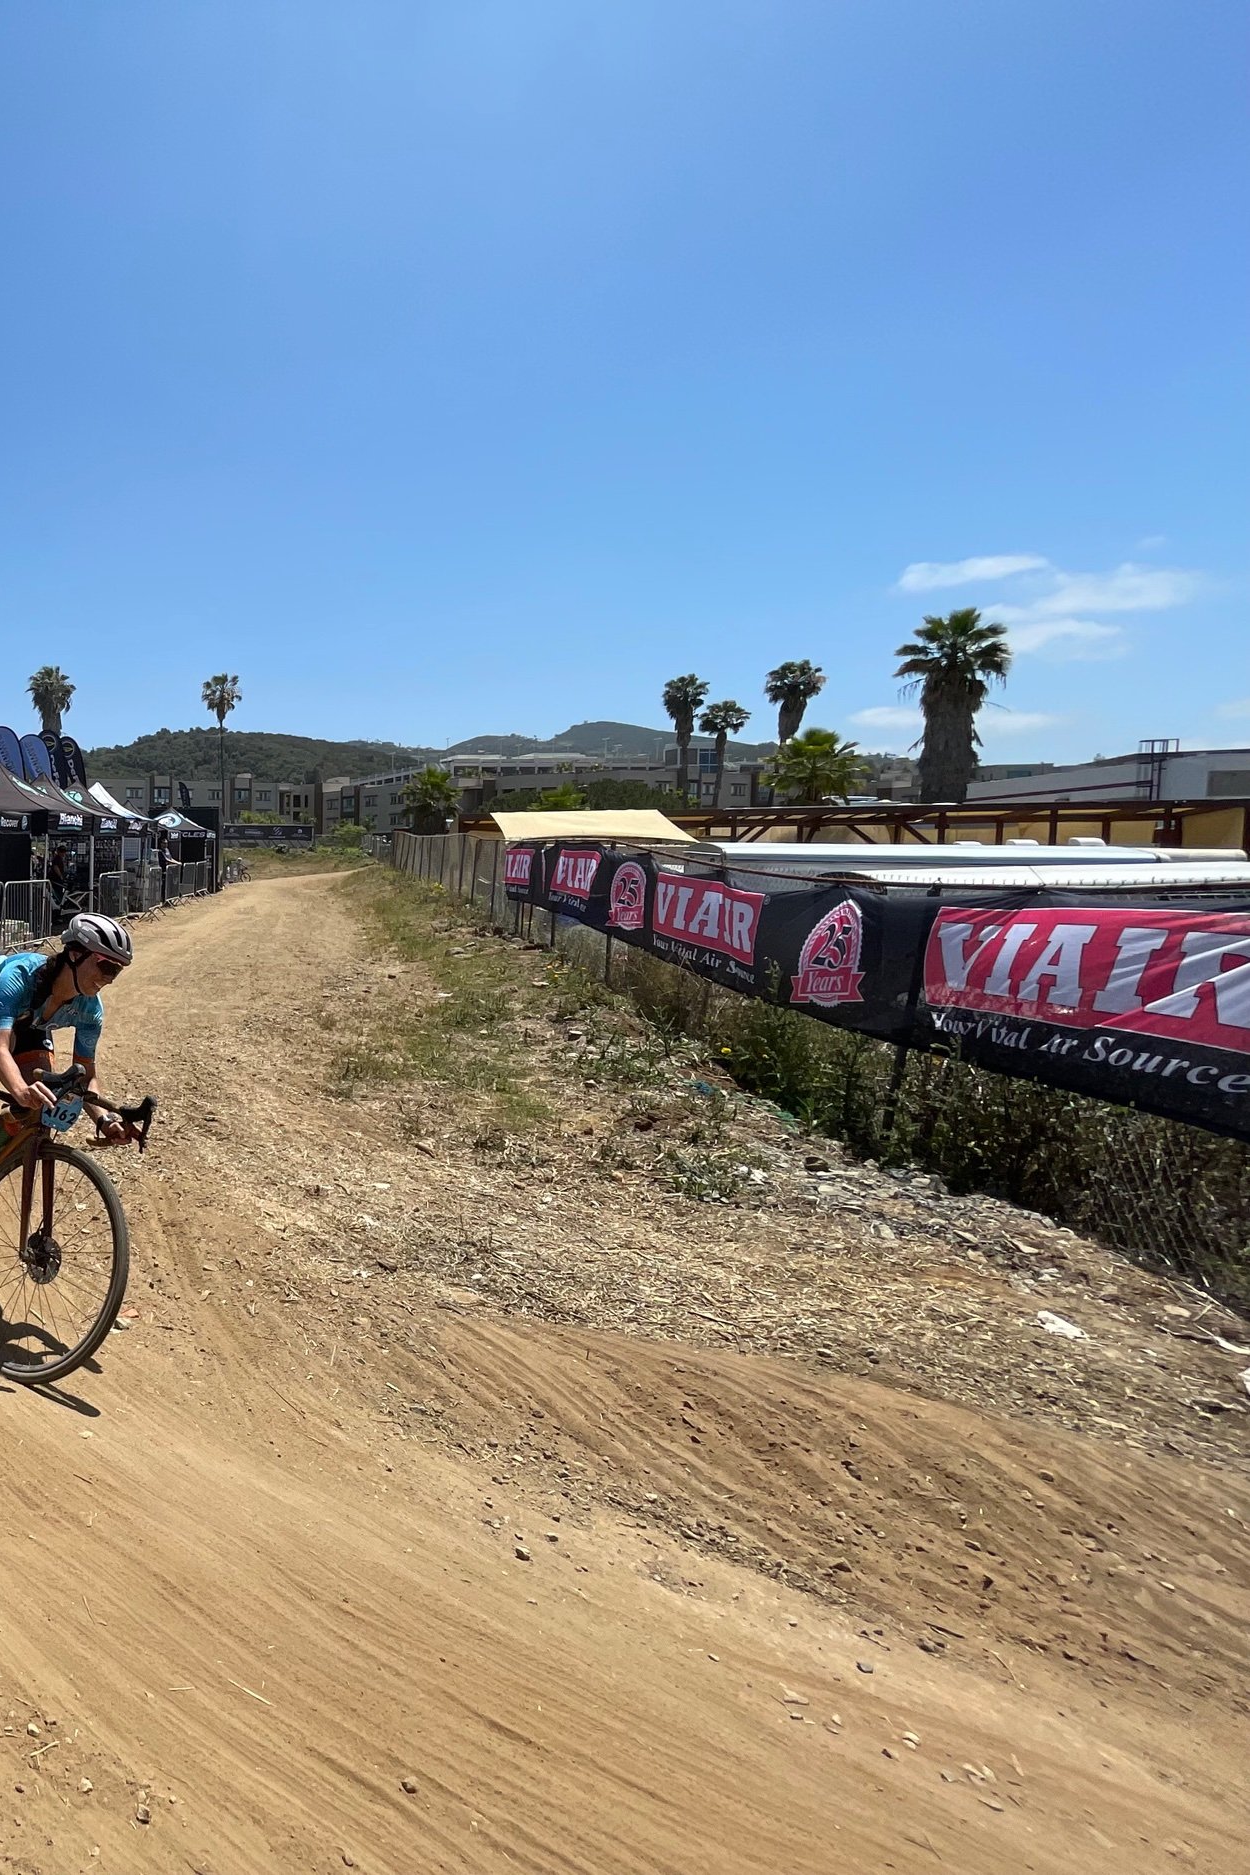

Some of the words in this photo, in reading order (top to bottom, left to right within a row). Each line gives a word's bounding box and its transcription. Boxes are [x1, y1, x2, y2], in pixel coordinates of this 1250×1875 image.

[0, 816, 20, 828] Recover
[616, 876, 640, 907] 25
[616, 907, 638, 921] Years
[652, 933, 670, 951] Your
[701, 953, 723, 969] Air
[811, 922, 854, 970] 25
[805, 971, 844, 993] Years
[937, 921, 1250, 1030] VIAIR
[974, 1019, 1032, 1050] Vital
[1038, 1033, 1079, 1055] Ar
[1082, 1036, 1250, 1094] Source
